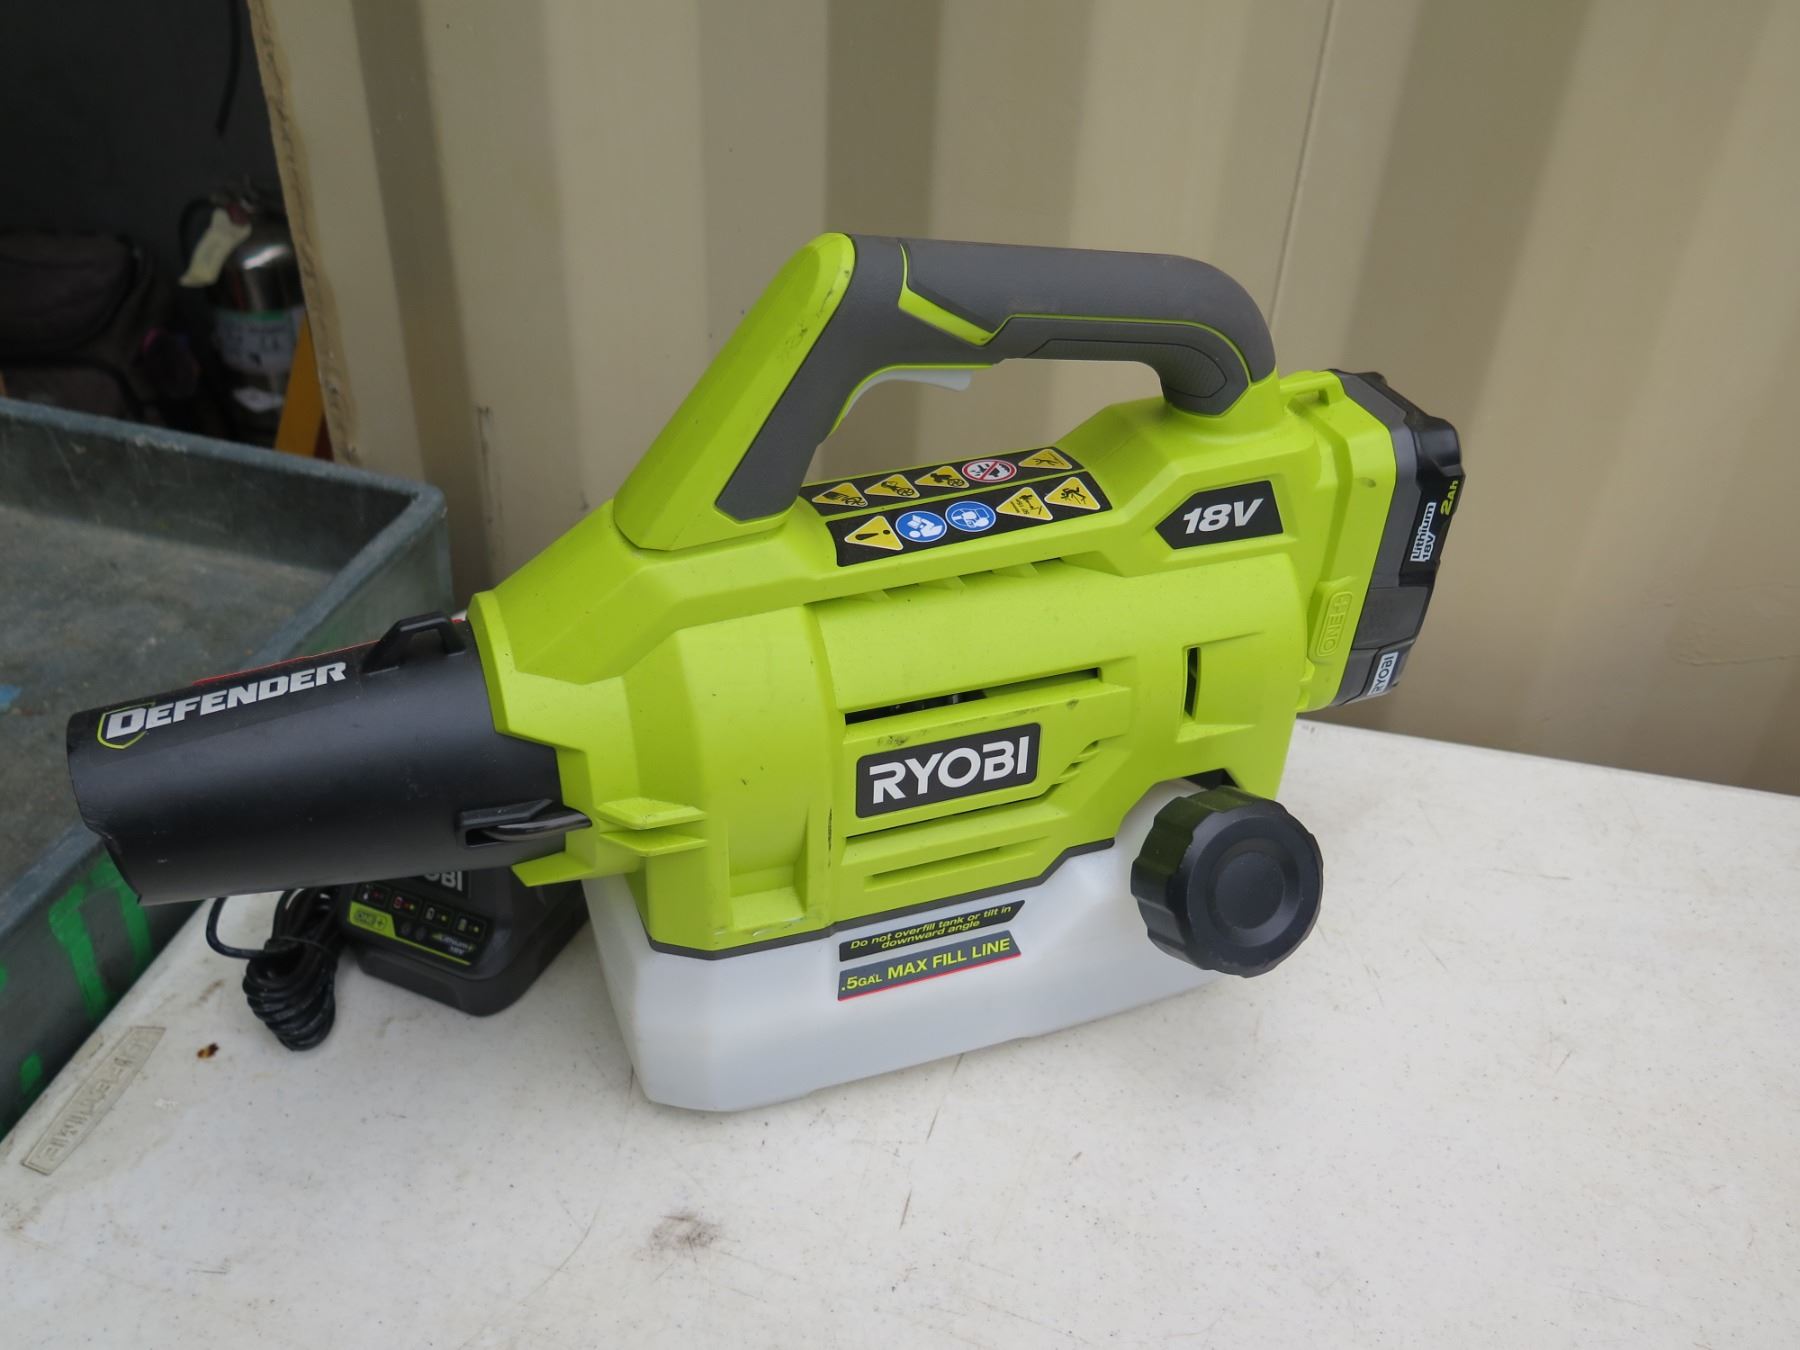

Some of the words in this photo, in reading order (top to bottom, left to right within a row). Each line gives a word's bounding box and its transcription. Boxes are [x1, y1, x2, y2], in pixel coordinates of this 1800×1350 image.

[1182, 497, 1264, 535] 18V
[1440, 480, 1459, 515] 2Ah
[1411, 504, 1435, 560] Lithium
[1422, 534, 1435, 559] 18V
[1370, 655, 1395, 694] RYOBI
[106, 661, 346, 740] DEFENDER
[869, 735, 1030, 805] RYOBI
[850, 940, 869, 950] Do
[871, 934, 893, 946] not
[895, 923, 936, 940] overfill
[939, 916, 965, 931] tank
[967, 912, 981, 923] or
[984, 907, 1000, 919] tilt
[1000, 904, 1012, 915] in
[881, 928, 946, 950] downward
[948, 919, 981, 935] angle
[841, 973, 884, 992] .5GAL
[887, 958, 929, 981] MAX
[932, 949, 968, 969] FILL
[971, 937, 1011, 959] LINE
